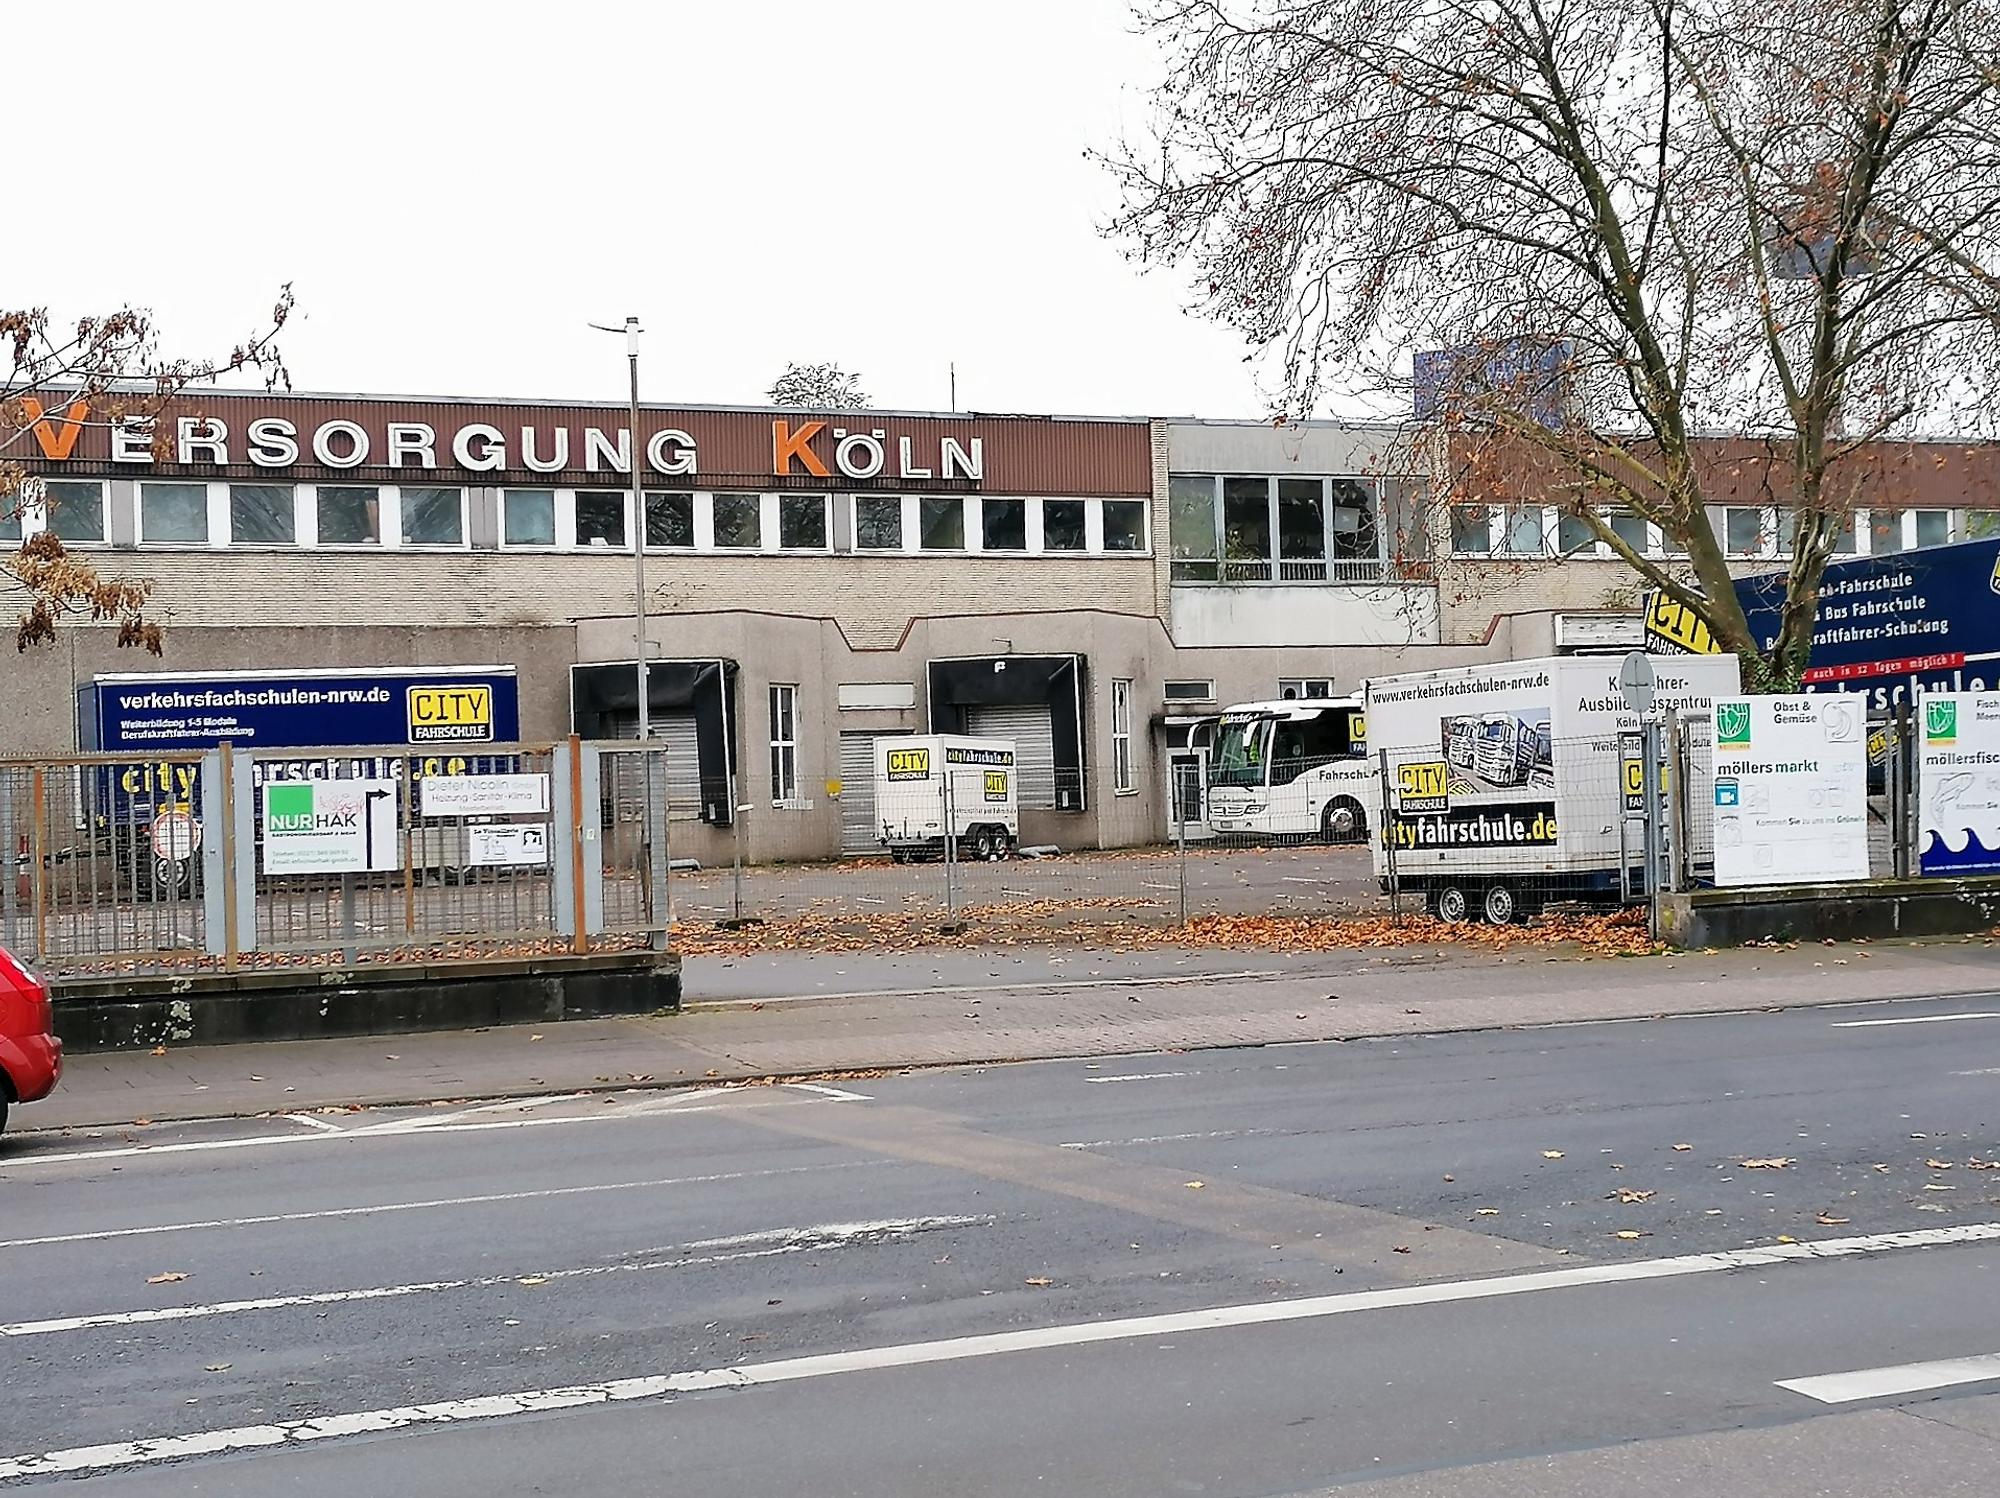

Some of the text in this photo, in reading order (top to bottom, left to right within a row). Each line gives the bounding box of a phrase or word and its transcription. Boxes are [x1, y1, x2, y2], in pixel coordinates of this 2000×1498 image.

[21, 396, 984, 481] VERSORGUNG KÖLN
[1825, 605, 1848, 621] Bus
[1852, 595, 1927, 617] Fahrschule
[119, 687, 391, 710] verkehrsfachschulen-nrw.de
[1373, 672, 1550, 705] www.verkehrsfachschulen-nrw.de
[416, 694, 483, 721] CITY
[1774, 701, 1811, 713] Obst &
[1774, 713, 1818, 725] Gemüse
[415, 726, 486, 739] FAHRSCHULE
[890, 752, 926, 770] CITY
[986, 773, 1006, 791] CITY
[1402, 767, 1445, 794] CITY
